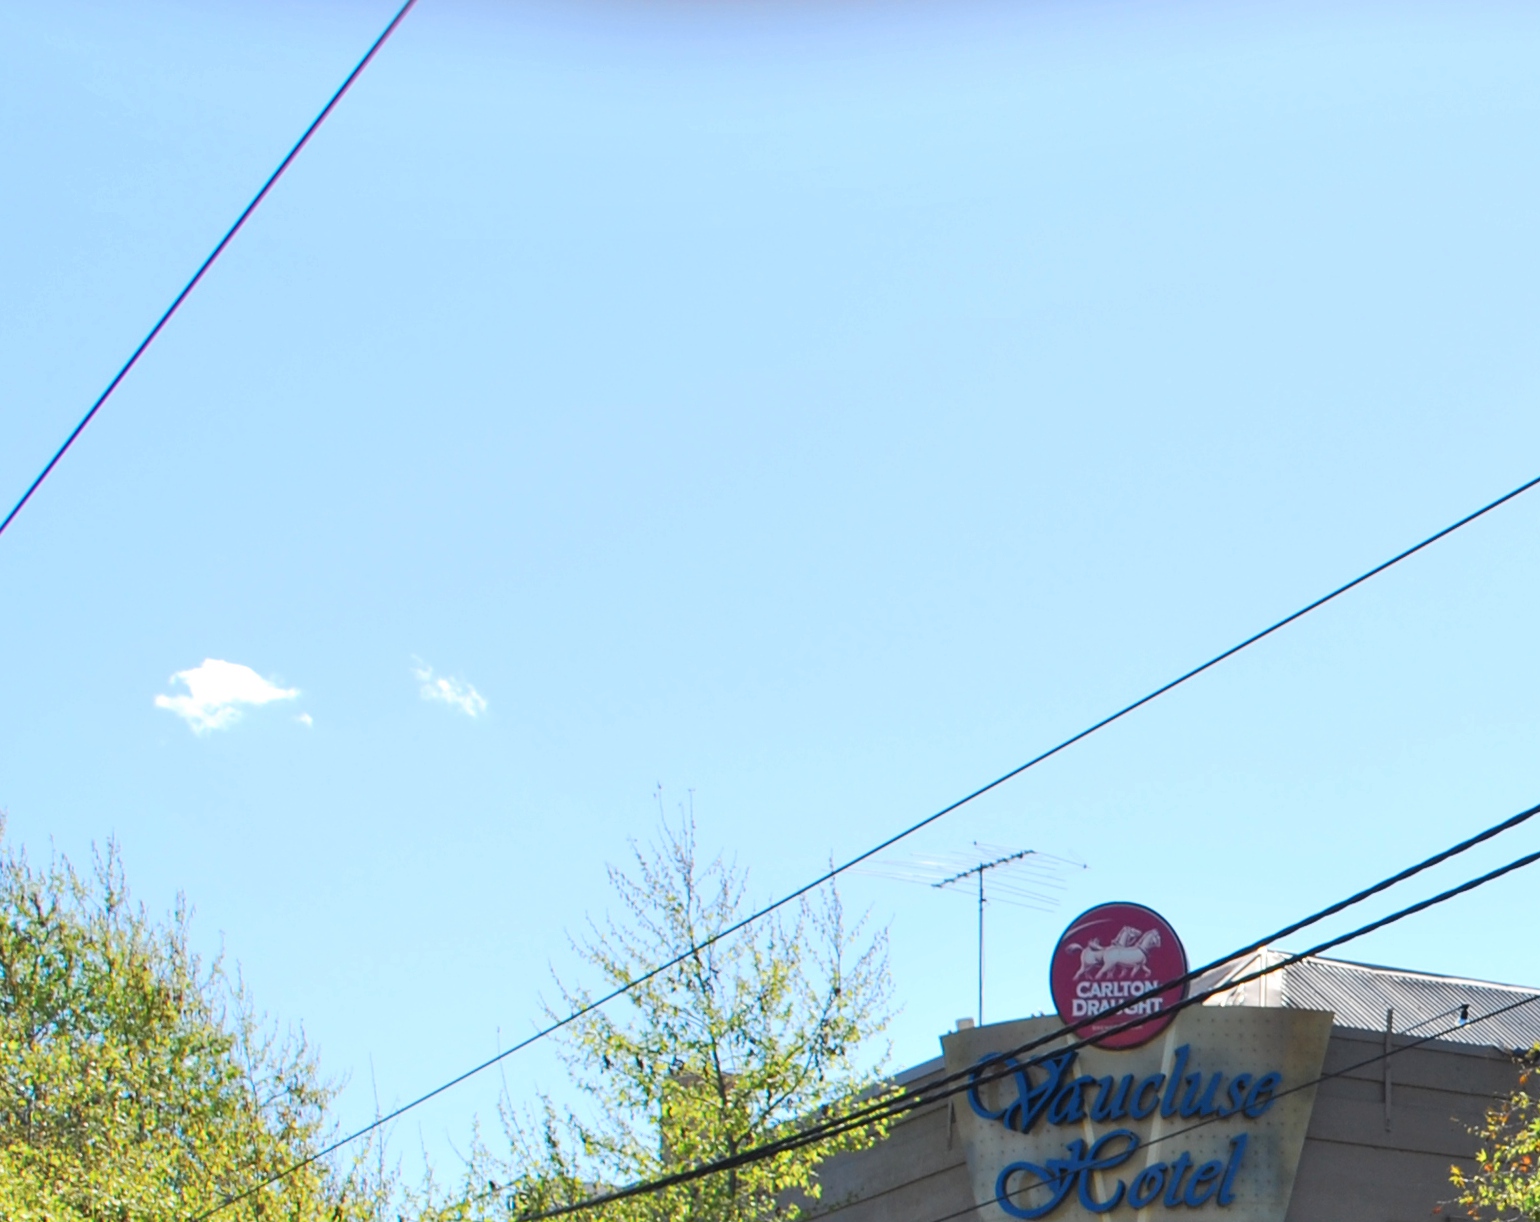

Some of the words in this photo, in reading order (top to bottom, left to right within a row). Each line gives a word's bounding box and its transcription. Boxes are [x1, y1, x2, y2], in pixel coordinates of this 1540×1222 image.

[1076, 981, 1159, 998] CARLTON
[967, 1044, 1283, 1135] Vaucluse
[995, 1128, 1249, 1220] Hotel
